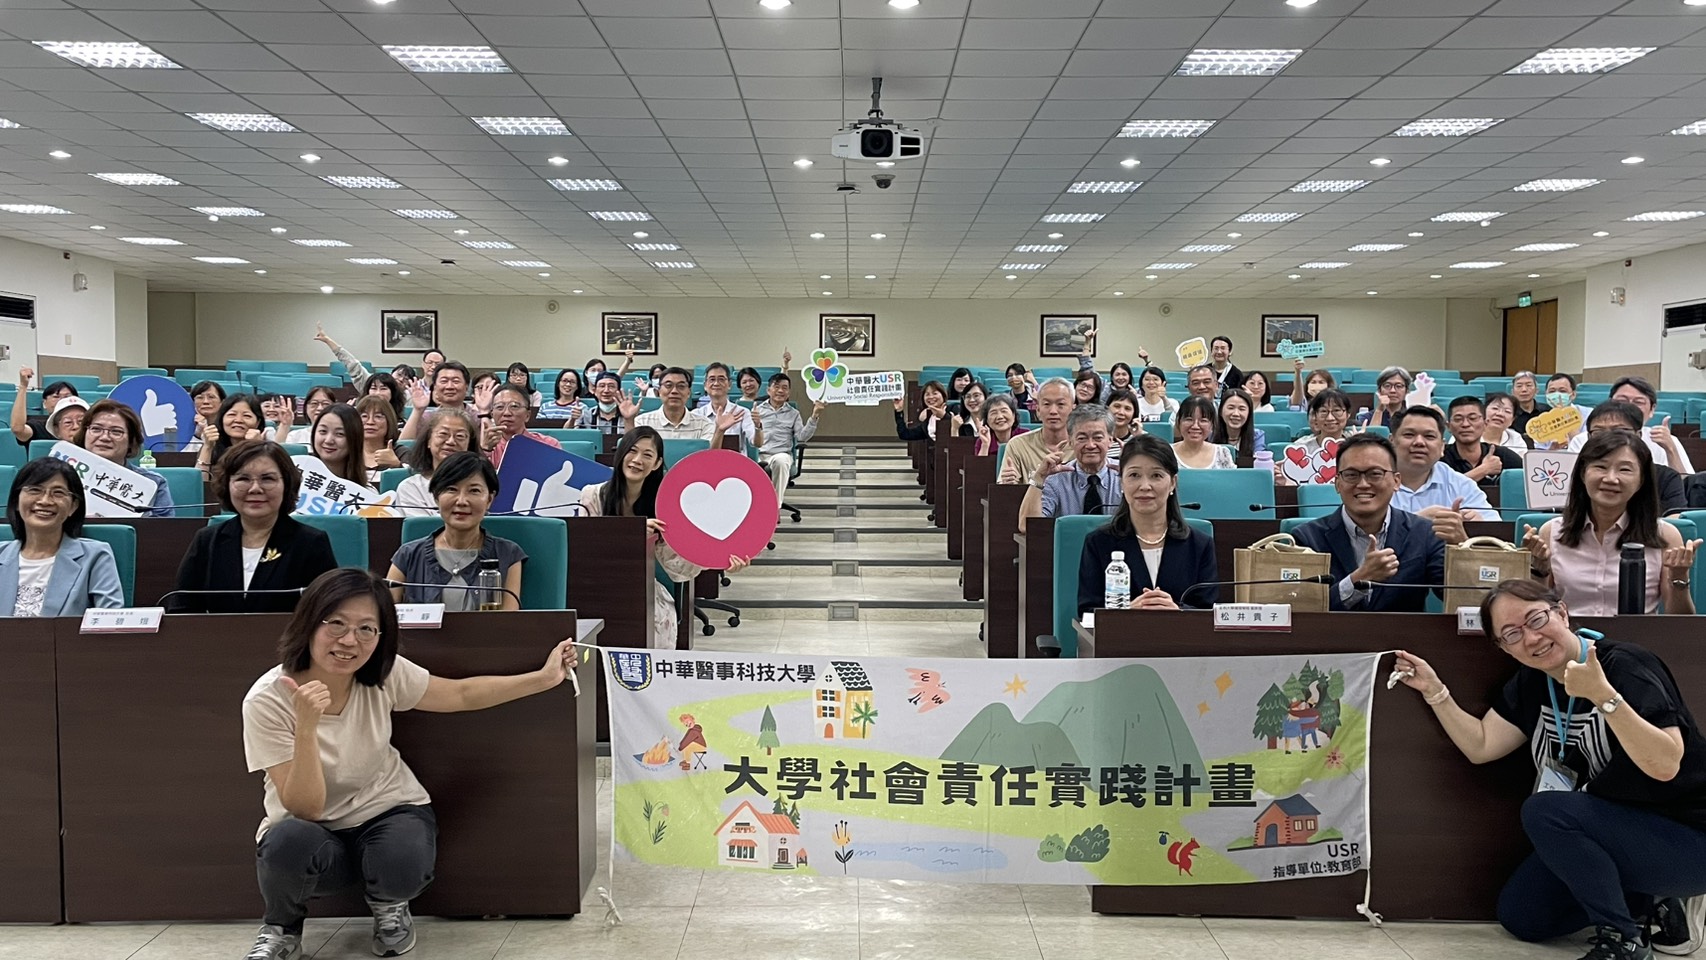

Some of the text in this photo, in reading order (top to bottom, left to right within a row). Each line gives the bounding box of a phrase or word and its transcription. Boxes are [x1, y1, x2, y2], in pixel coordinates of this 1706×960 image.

[1220, 612, 1279, 622] 松井貴子
[656, 659, 816, 683] 中華醫事科技大學
[722, 756, 1258, 809] 大學社會責任實踐計畫
[1327, 843, 1359, 858] USR
[1273, 856, 1362, 878] 指導單位:教育部
